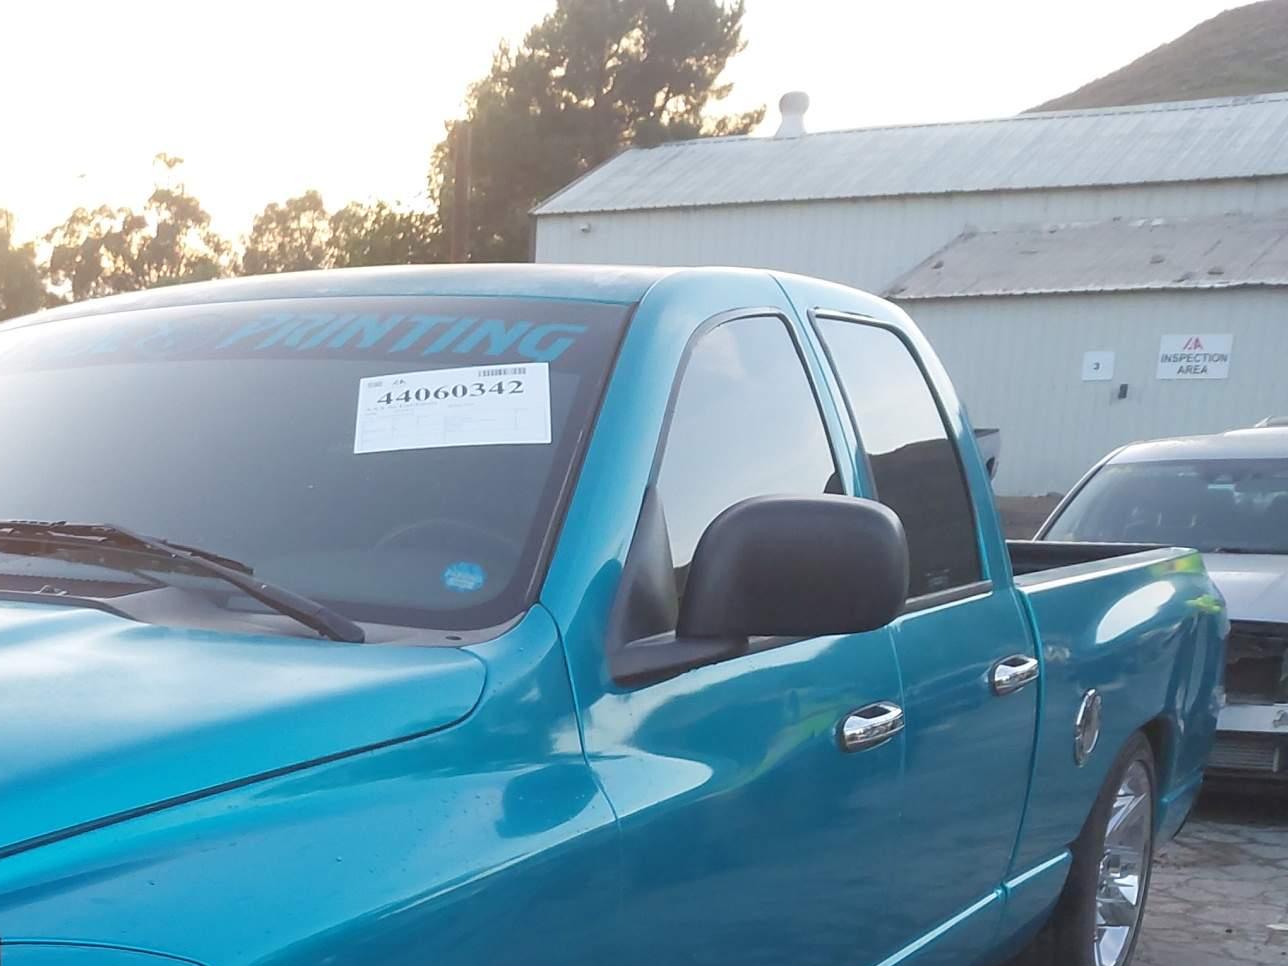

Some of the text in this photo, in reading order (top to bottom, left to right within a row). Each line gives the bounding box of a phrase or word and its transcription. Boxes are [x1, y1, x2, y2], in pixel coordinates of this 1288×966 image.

[216, 312, 588, 361] PRINTING
[1161, 353, 1228, 363] INSPECTION
[1177, 365, 1208, 375] AREA
[377, 380, 524, 404] 44060342
